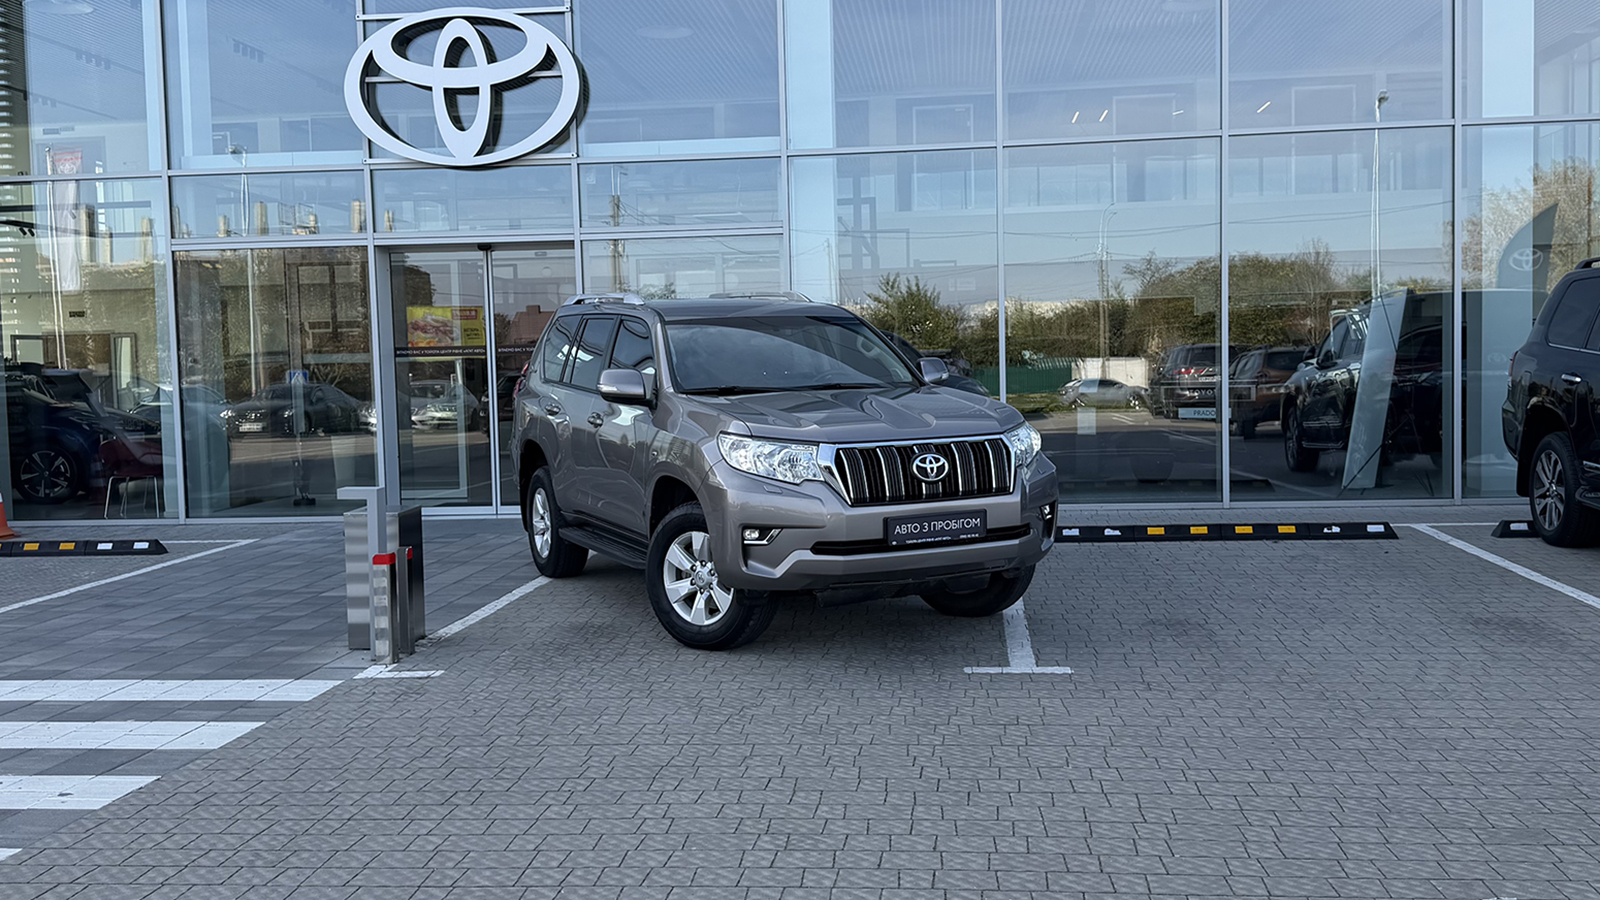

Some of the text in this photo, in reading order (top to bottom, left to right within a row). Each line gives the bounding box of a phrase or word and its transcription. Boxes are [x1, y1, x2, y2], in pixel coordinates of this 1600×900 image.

[894, 518, 981, 535] АВТО З ПРОБІГОМ
